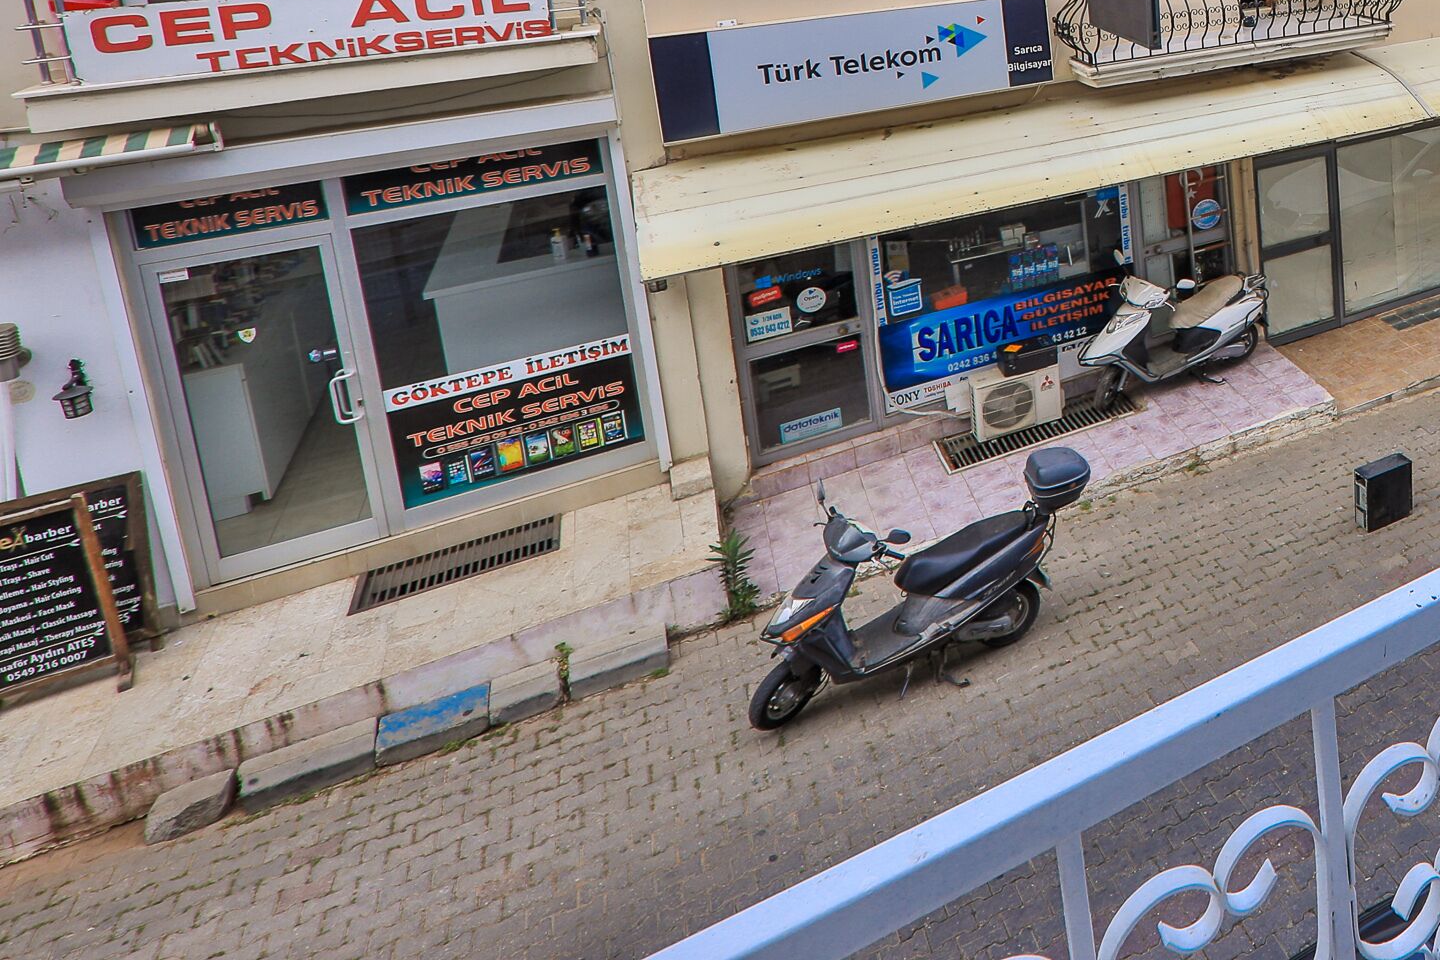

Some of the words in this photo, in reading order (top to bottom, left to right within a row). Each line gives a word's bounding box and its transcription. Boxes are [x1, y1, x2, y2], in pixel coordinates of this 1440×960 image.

[90, 3, 272, 54] CEP
[1014, 45, 1043, 55] Sarıca
[758, 58, 822, 84] Türk
[830, 45, 942, 76] Telekom
[1008, 60, 1052, 72] Bilgisayar
[918, 304, 1019, 362] SARICA
[948, 359, 971, 372] 0242
[1063, 330, 1074, 340] 42
[1076, 326, 1087, 336] 12
[391, 366, 512, 406] GÖKTEPE
[526, 338, 629, 374] İLETİŞİM
[923, 381, 952, 392] TOSHIBA
[453, 388, 511, 414] CEP
[25, 525, 72, 543] barber
[24, 556, 40, 566] Hair
[40, 553, 54, 561] Cut
[28, 568, 50, 578] Shave
[31, 582, 47, 591] Hair
[48, 575, 74, 587] Styling
[35, 594, 50, 604] Hair
[51, 586, 82, 600] Coloring
[38, 607, 55, 616] Face
[56, 601, 76, 611] Mask
[13, 625, 35, 637] Masaj
[42, 618, 65, 630] Classic
[66, 608, 98, 622] Massage
[16, 638, 39, 651] Masaj
[30, 648, 65, 664] Aydın
[67, 636, 96, 652] ATEŞ
[7, 667, 35, 682] 0549
[37, 660, 59, 672] 216
[60, 650, 88, 665] 0007
